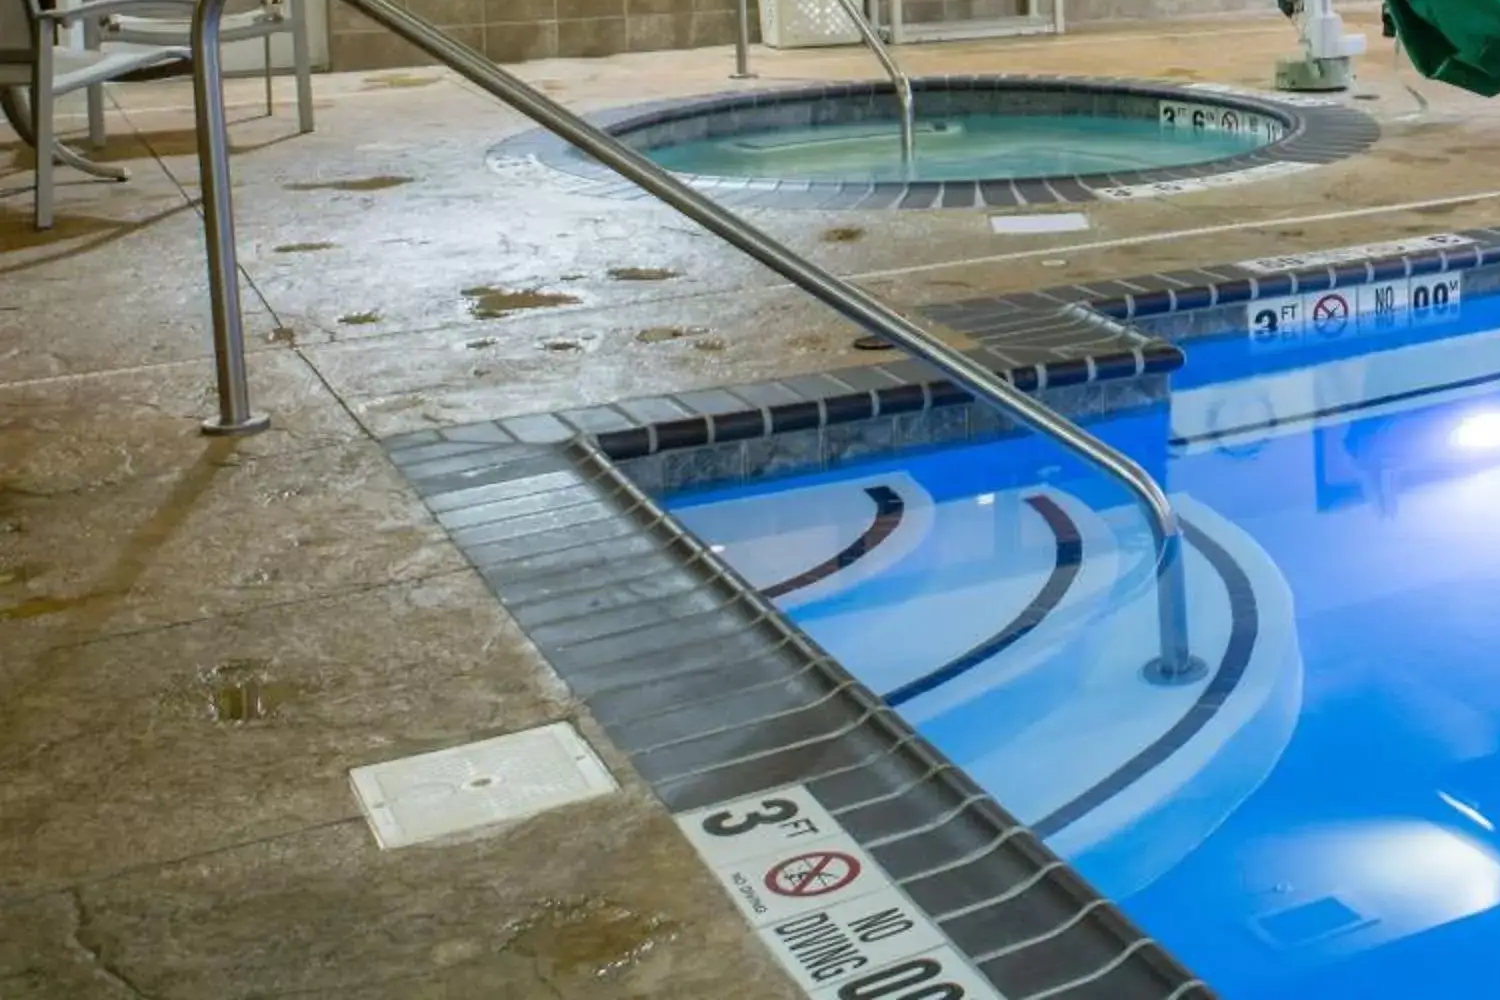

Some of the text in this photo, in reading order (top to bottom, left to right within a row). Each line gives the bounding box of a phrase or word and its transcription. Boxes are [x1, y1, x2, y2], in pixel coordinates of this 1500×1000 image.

[1375, 286, 1394, 313] NO
[1449, 279, 1459, 291] M
[1281, 303, 1299, 321] FT
[703, 797, 820, 839] 3 FT
[732, 871, 769, 915] NO DIVING
[848, 906, 914, 943] NO
[774, 911, 868, 983] DIVING
